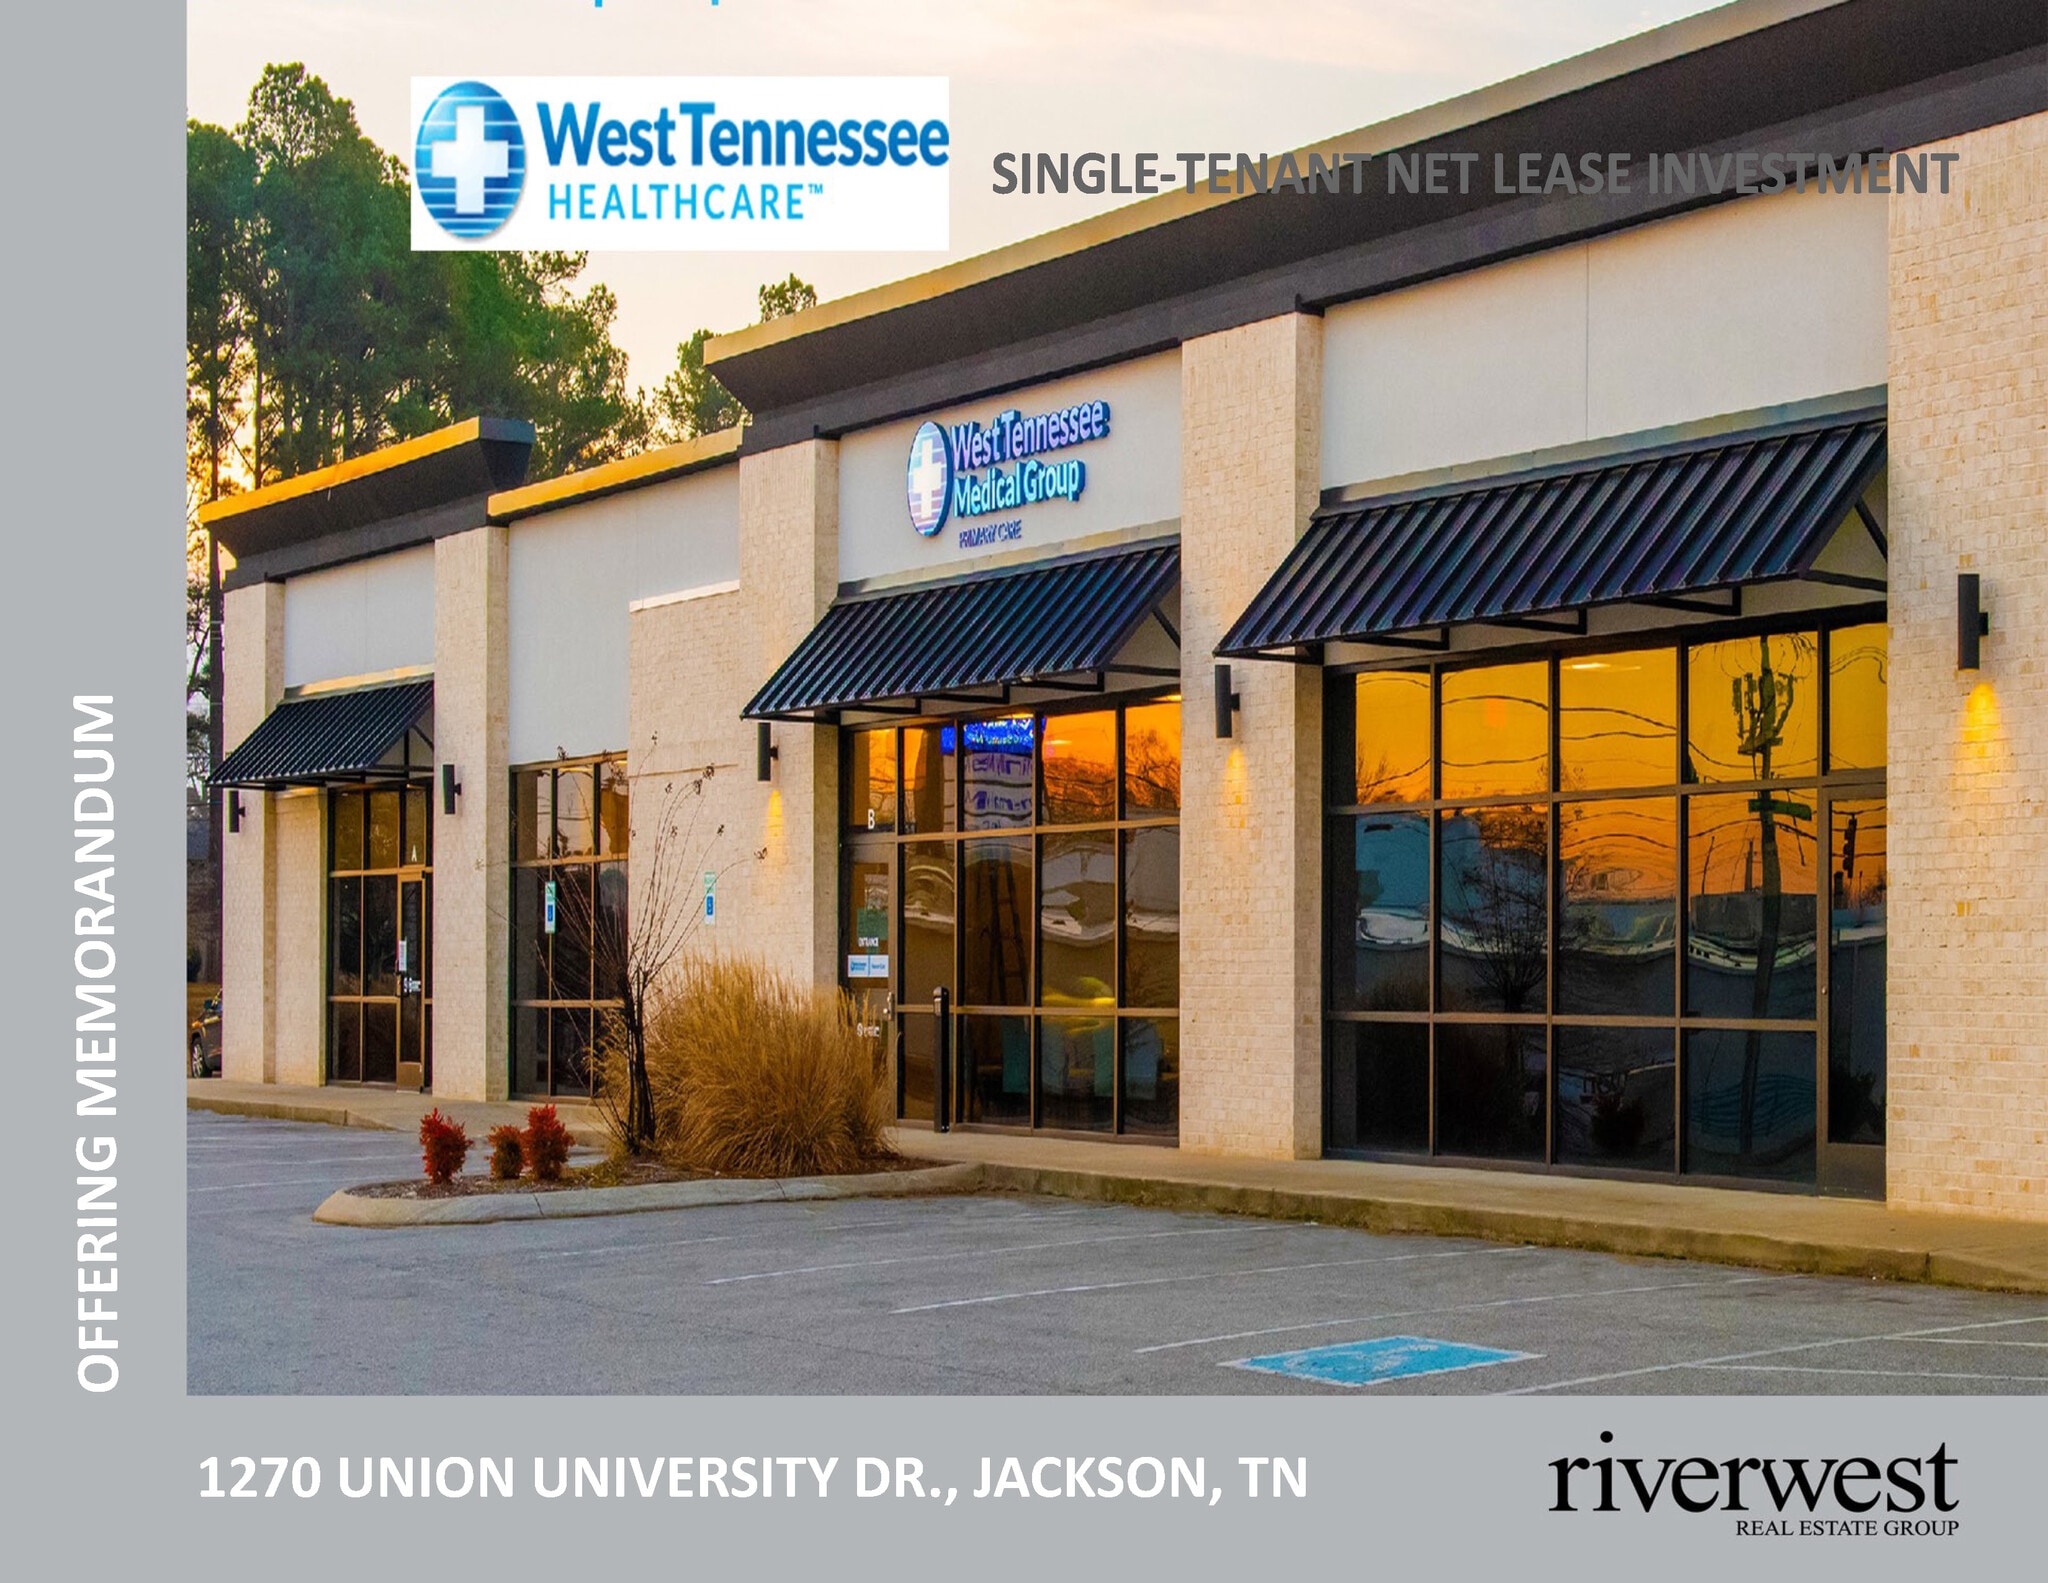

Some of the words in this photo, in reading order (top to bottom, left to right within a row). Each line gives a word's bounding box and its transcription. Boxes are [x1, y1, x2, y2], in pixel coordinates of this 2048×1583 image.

[951, 418, 1001, 471] West
[1001, 401, 1110, 460] Tennessee
[953, 467, 1021, 517] Medical
[1022, 459, 1085, 501] Group
[997, 519, 1022, 542] CARE
[868, 809, 875, 829] B
[411, 845, 418, 863] A
